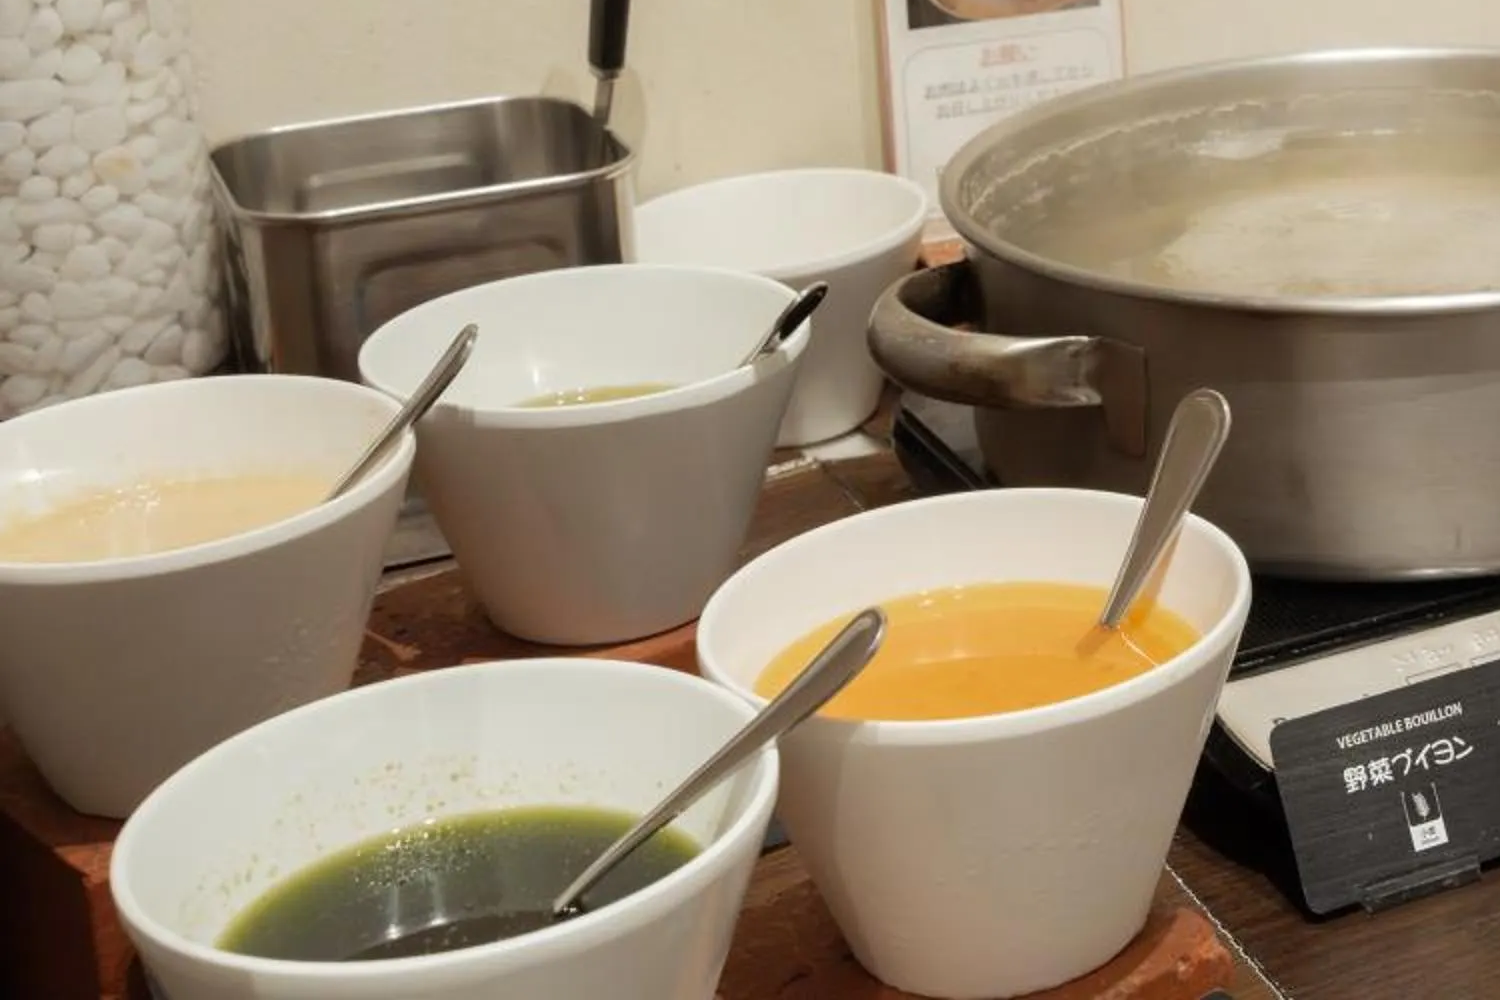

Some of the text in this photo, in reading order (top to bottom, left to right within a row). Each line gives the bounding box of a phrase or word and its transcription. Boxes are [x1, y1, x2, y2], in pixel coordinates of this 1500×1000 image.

[1336, 701, 1464, 749] VEGETABLE BOUILLON
[1343, 736, 1475, 794] 野菜ブイヨン
